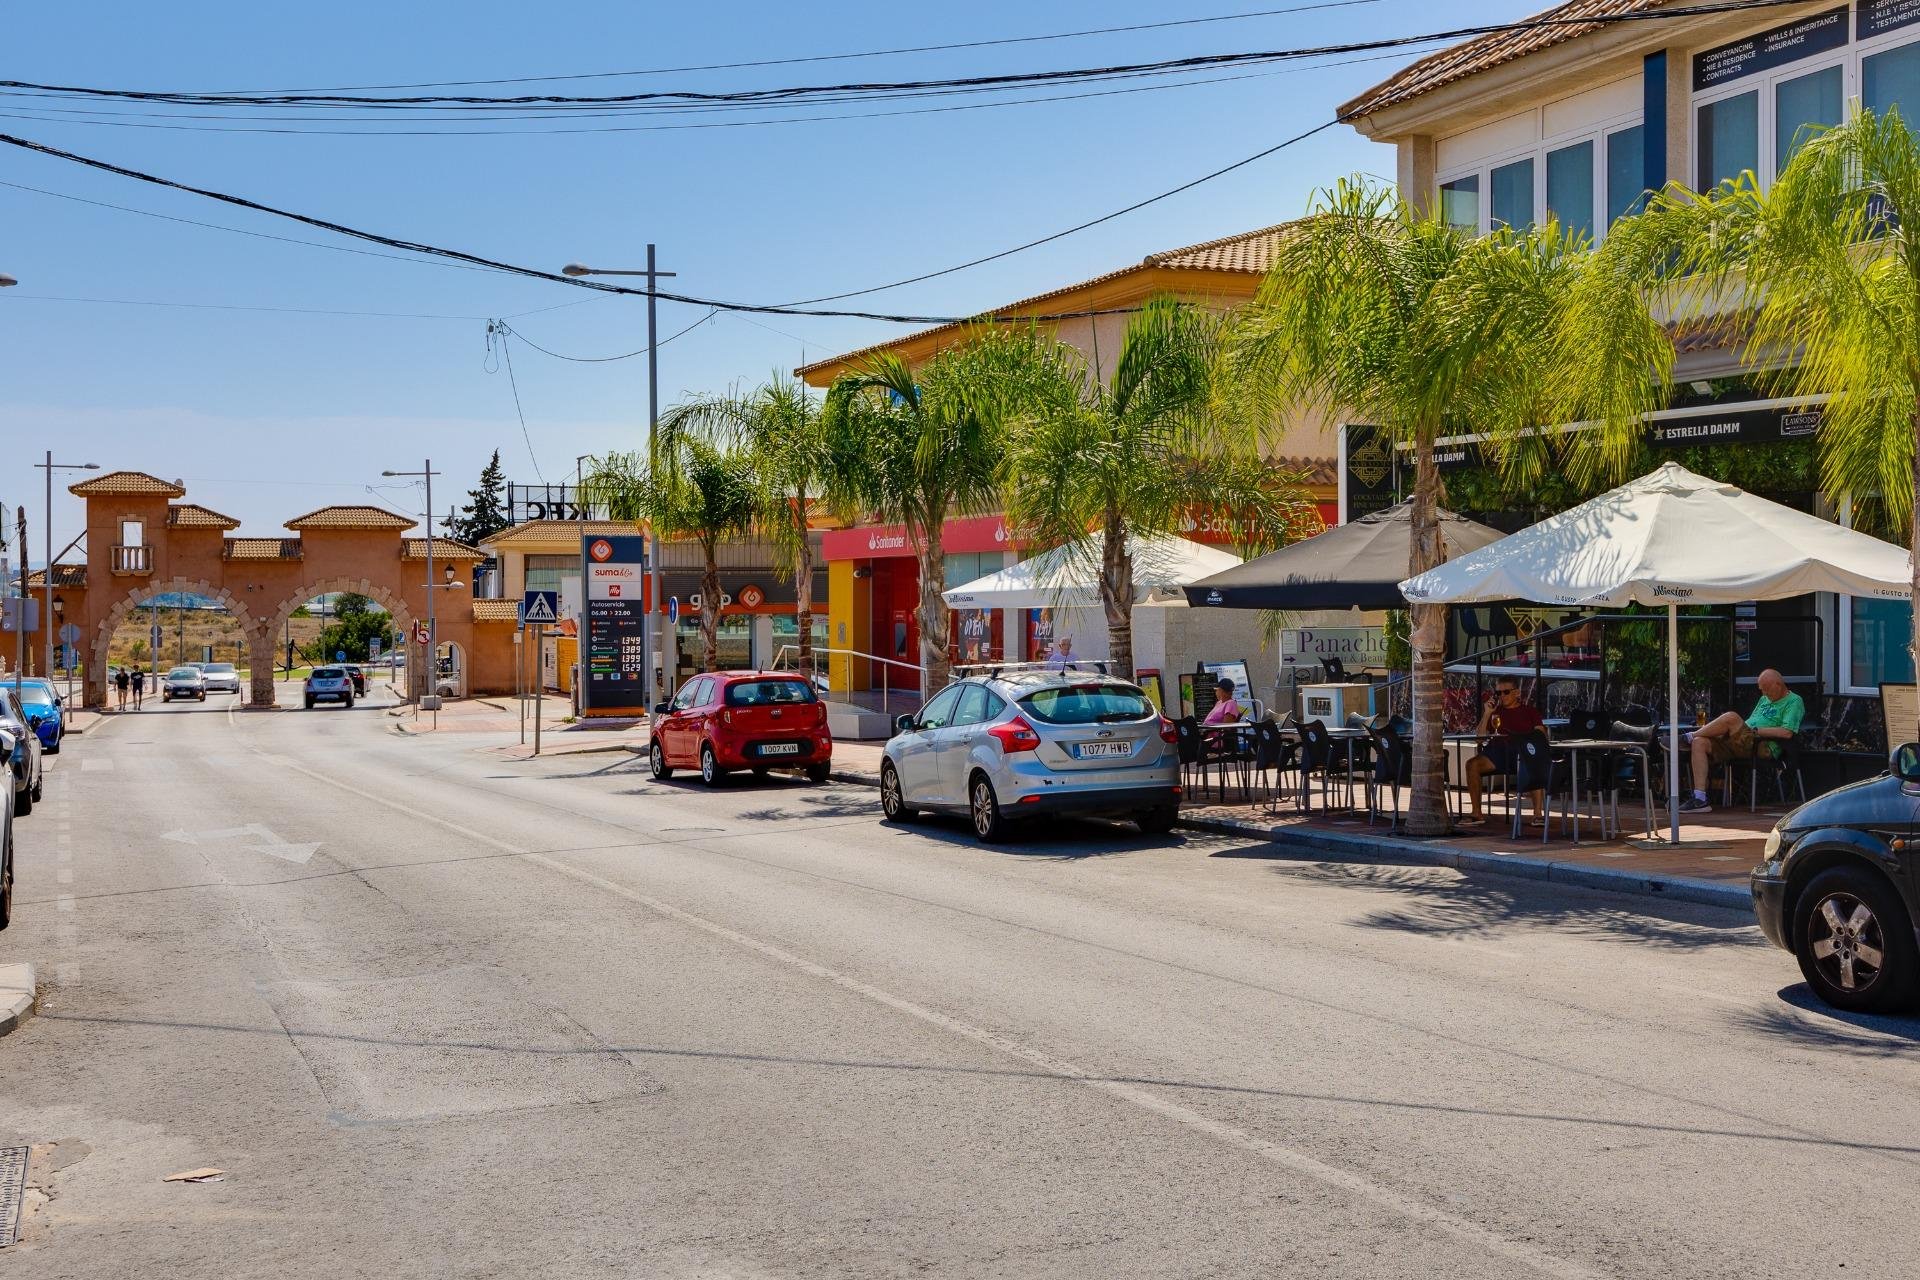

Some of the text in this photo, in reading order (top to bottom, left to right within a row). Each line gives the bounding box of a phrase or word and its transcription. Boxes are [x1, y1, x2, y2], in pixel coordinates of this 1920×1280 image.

[1769, 15, 1839, 43] WILLS & INHERITANCE
[1706, 42, 1753, 62] CONVEYANCING
[1768, 35, 1805, 52] INSURANCE
[1707, 64, 1716, 72] NIE
[1723, 51, 1756, 66] RESIDENCE
[1706, 65, 1742, 80] CONTRACTS
[1666, 423, 1740, 439] ESTRELLA DAMM
[1444, 451, 1465, 462] DAMM
[876, 536, 904, 549] Santander
[690, 594, 732, 611] gp
[1300, 630, 1388, 653] Panache
[1083, 743, 1106, 755] 1077
